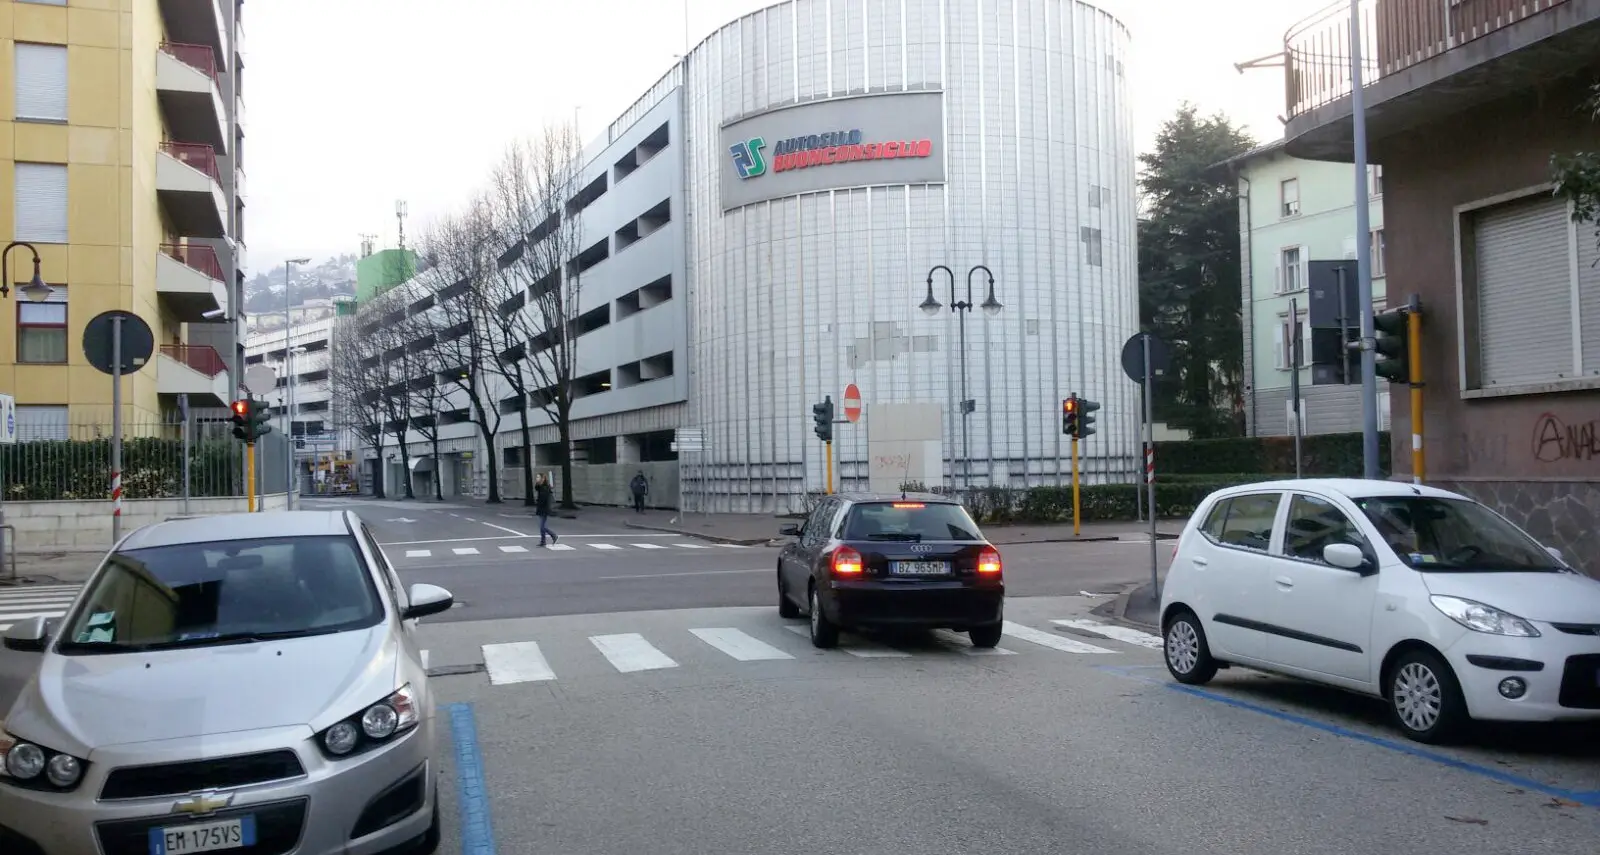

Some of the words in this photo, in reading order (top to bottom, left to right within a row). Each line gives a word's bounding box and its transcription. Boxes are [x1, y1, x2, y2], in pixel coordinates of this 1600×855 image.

[773, 129, 861, 156] AUTOSILO
[773, 140, 931, 173] BUONCONSIGLIO
[899, 562, 910, 573] BZ
[914, 562, 944, 573] 963MP
[165, 831, 186, 851] EM
[193, 825, 241, 848] 175VS
